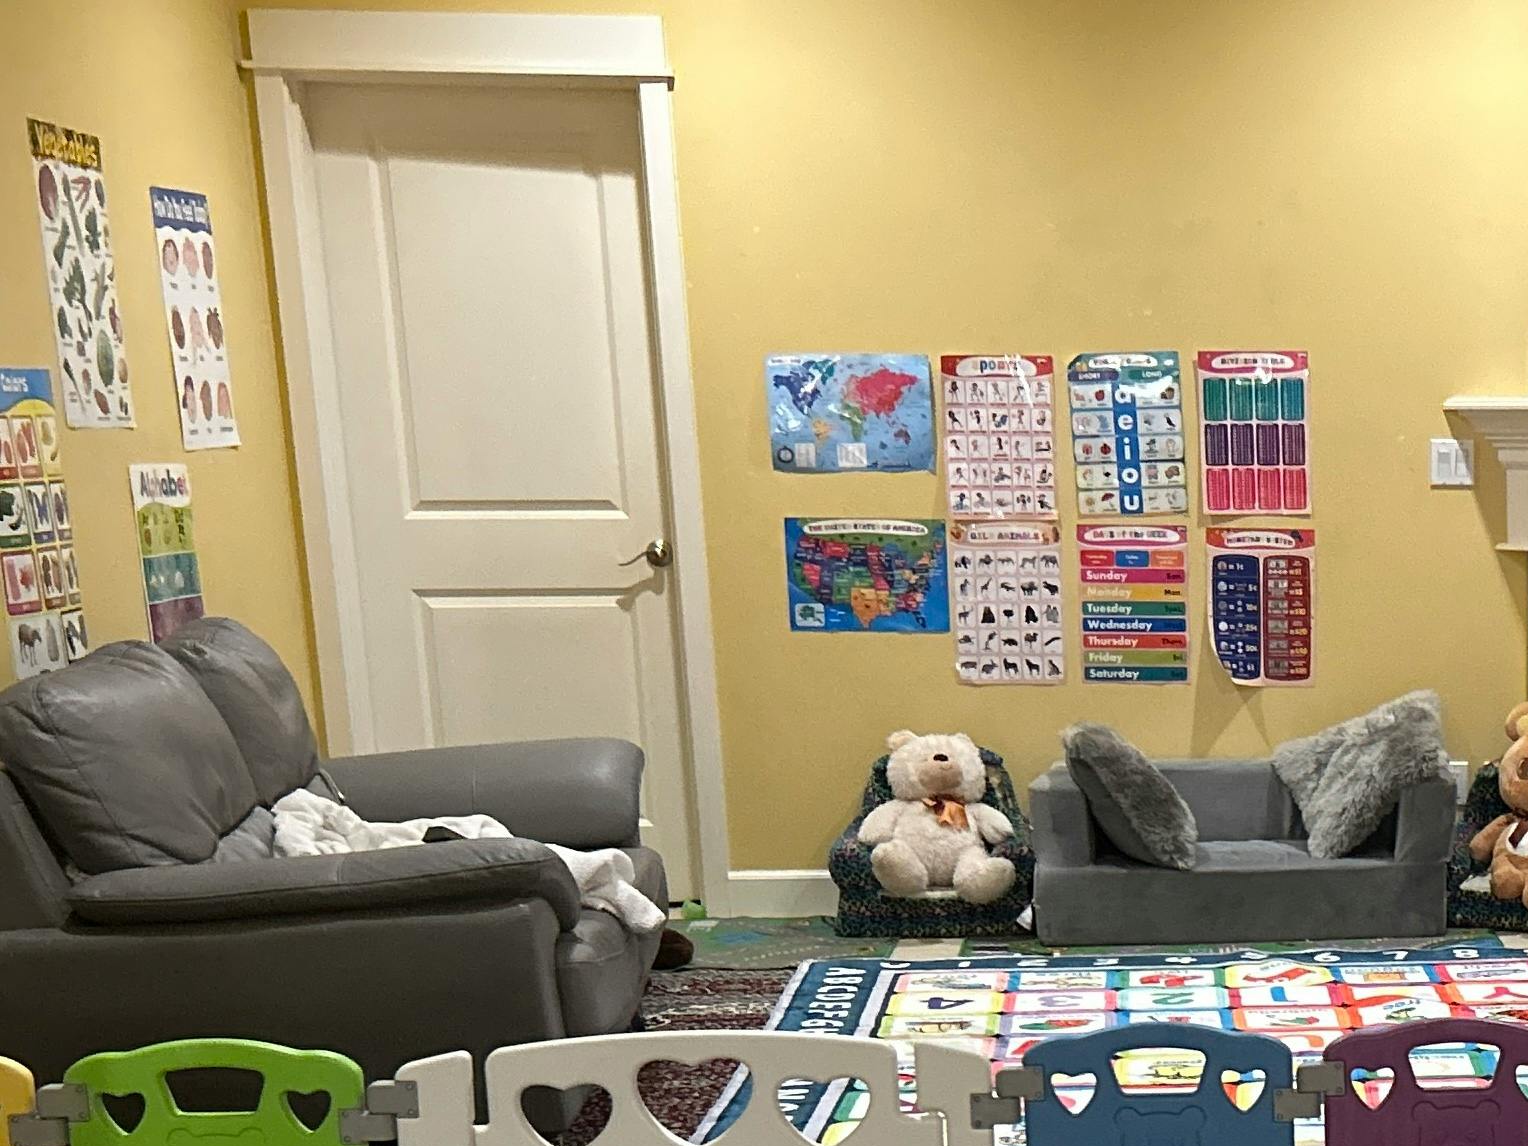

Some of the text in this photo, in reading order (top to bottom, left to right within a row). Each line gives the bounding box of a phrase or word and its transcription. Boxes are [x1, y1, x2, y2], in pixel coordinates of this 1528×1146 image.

[34, 122, 98, 166] Vegetables
[1118, 415, 1133, 430] e
[1123, 437, 1131, 460] i
[1086, 570, 1128, 582] Sunday
[1086, 602, 1132, 614] Tuesday
[1088, 619, 1152, 631] Wednesday
[1088, 636, 1139, 647] Thursday
[1088, 652, 1123, 664] Friday
[1089, 669, 1139, 680] Saturday
[1313, 951, 1341, 964] 6
[1382, 951, 1410, 961] 7
[1452, 948, 1480, 959] 8
